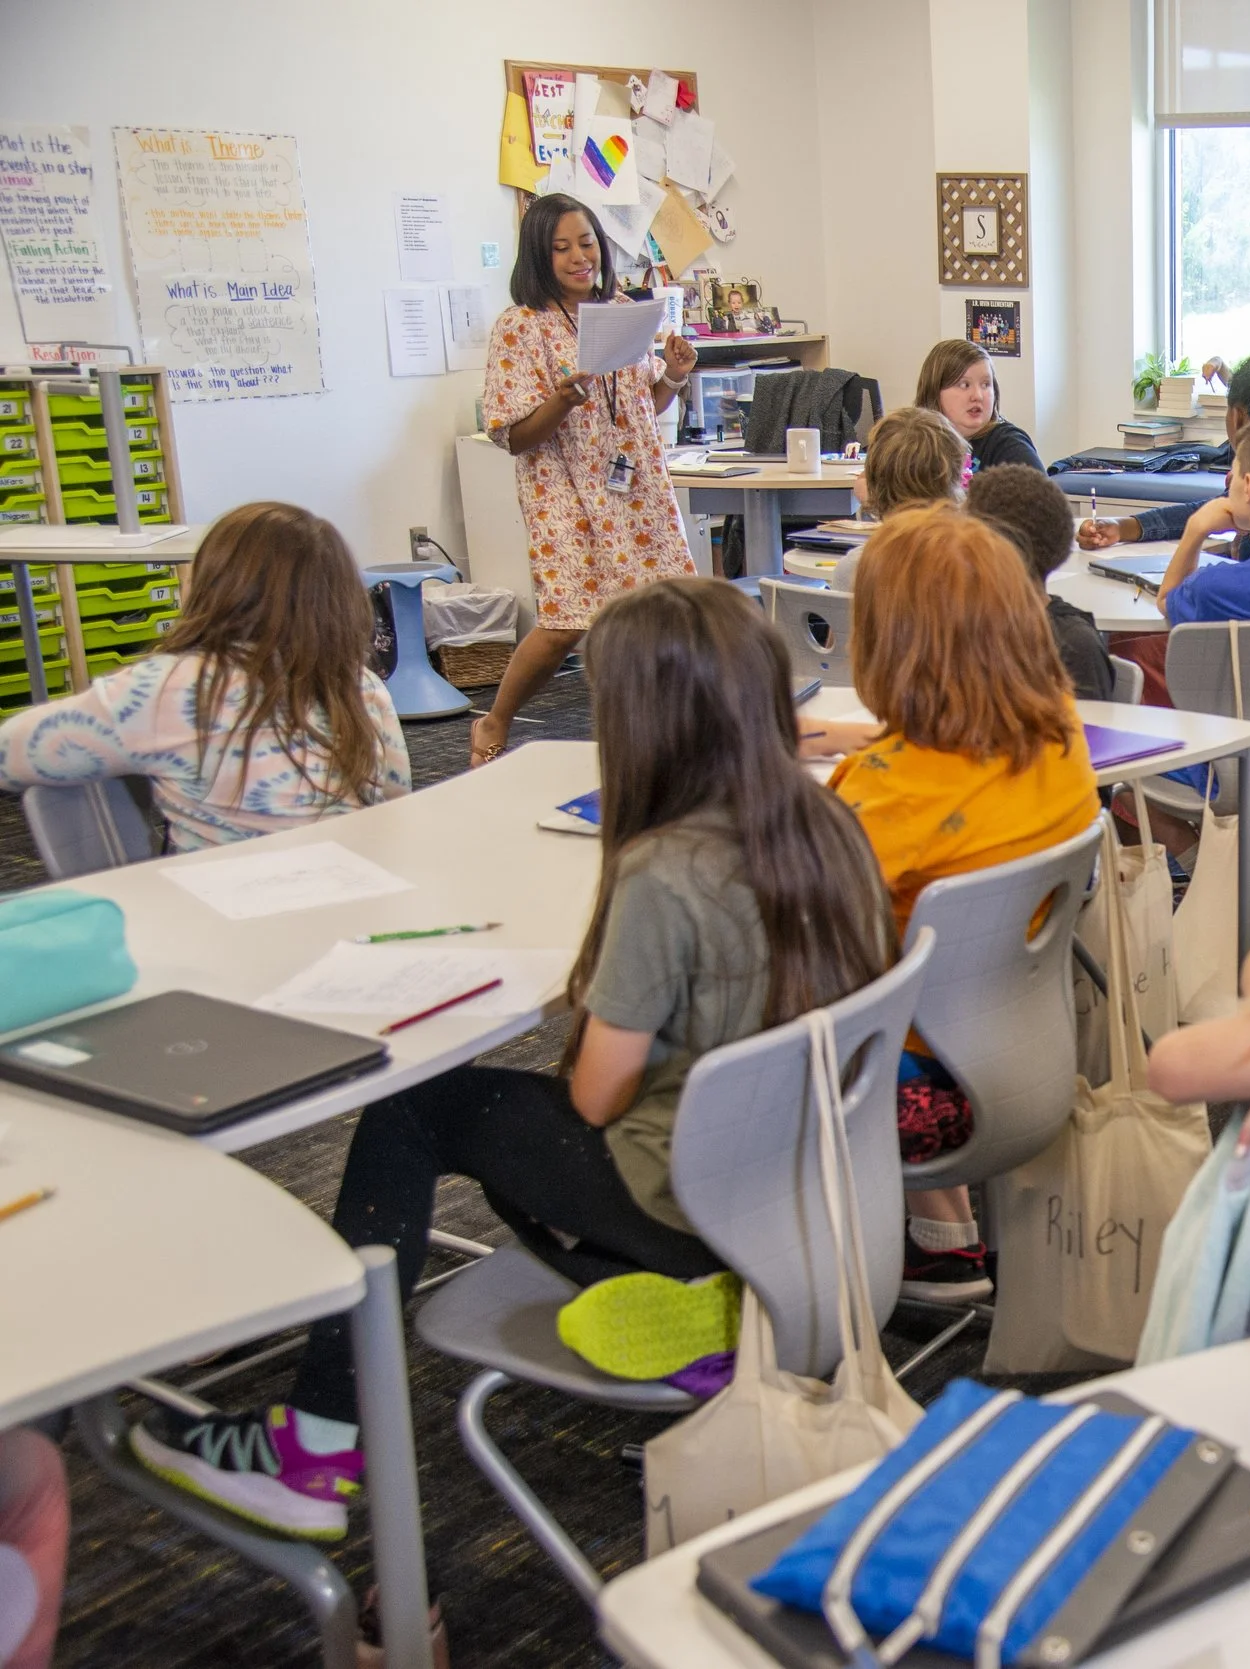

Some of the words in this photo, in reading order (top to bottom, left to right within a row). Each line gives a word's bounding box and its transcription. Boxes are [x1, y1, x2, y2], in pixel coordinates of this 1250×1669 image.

[31, 140, 44, 153] is
[48, 133, 73, 155] the
[136, 134, 177, 153] What
[204, 136, 264, 158] Theme
[42, 162, 55, 174] in
[57, 163, 65, 174] a
[976, 214, 986, 240] S
[12, 244, 52, 259] Falling
[54, 242, 89, 256] Action
[166, 280, 200, 299] What
[227, 281, 258, 299] Main
[261, 281, 295, 298] Idea
[184, 304, 207, 317] The
[212, 305, 237, 317] main
[243, 304, 270, 315] idea
[273, 302, 283, 315] of
[180, 318, 187, 326] a
[193, 317, 216, 326] text
[224, 317, 232, 325] is
[249, 316, 294, 327] sentence
[187, 326, 205, 337] that
[208, 366, 226, 376] the
[230, 364, 266, 378] question
[270, 364, 293, 374] what
[186, 378, 203, 389] this
[208, 377, 230, 392] story
[2, 403, 12, 414] 21
[133, 429, 142, 439] 12
[10, 439, 23, 449] 22
[139, 464, 148, 473] 13
[142, 494, 151, 503] 14
[156, 590, 165, 599] 17
[1047, 1195, 1144, 1294] Riley
